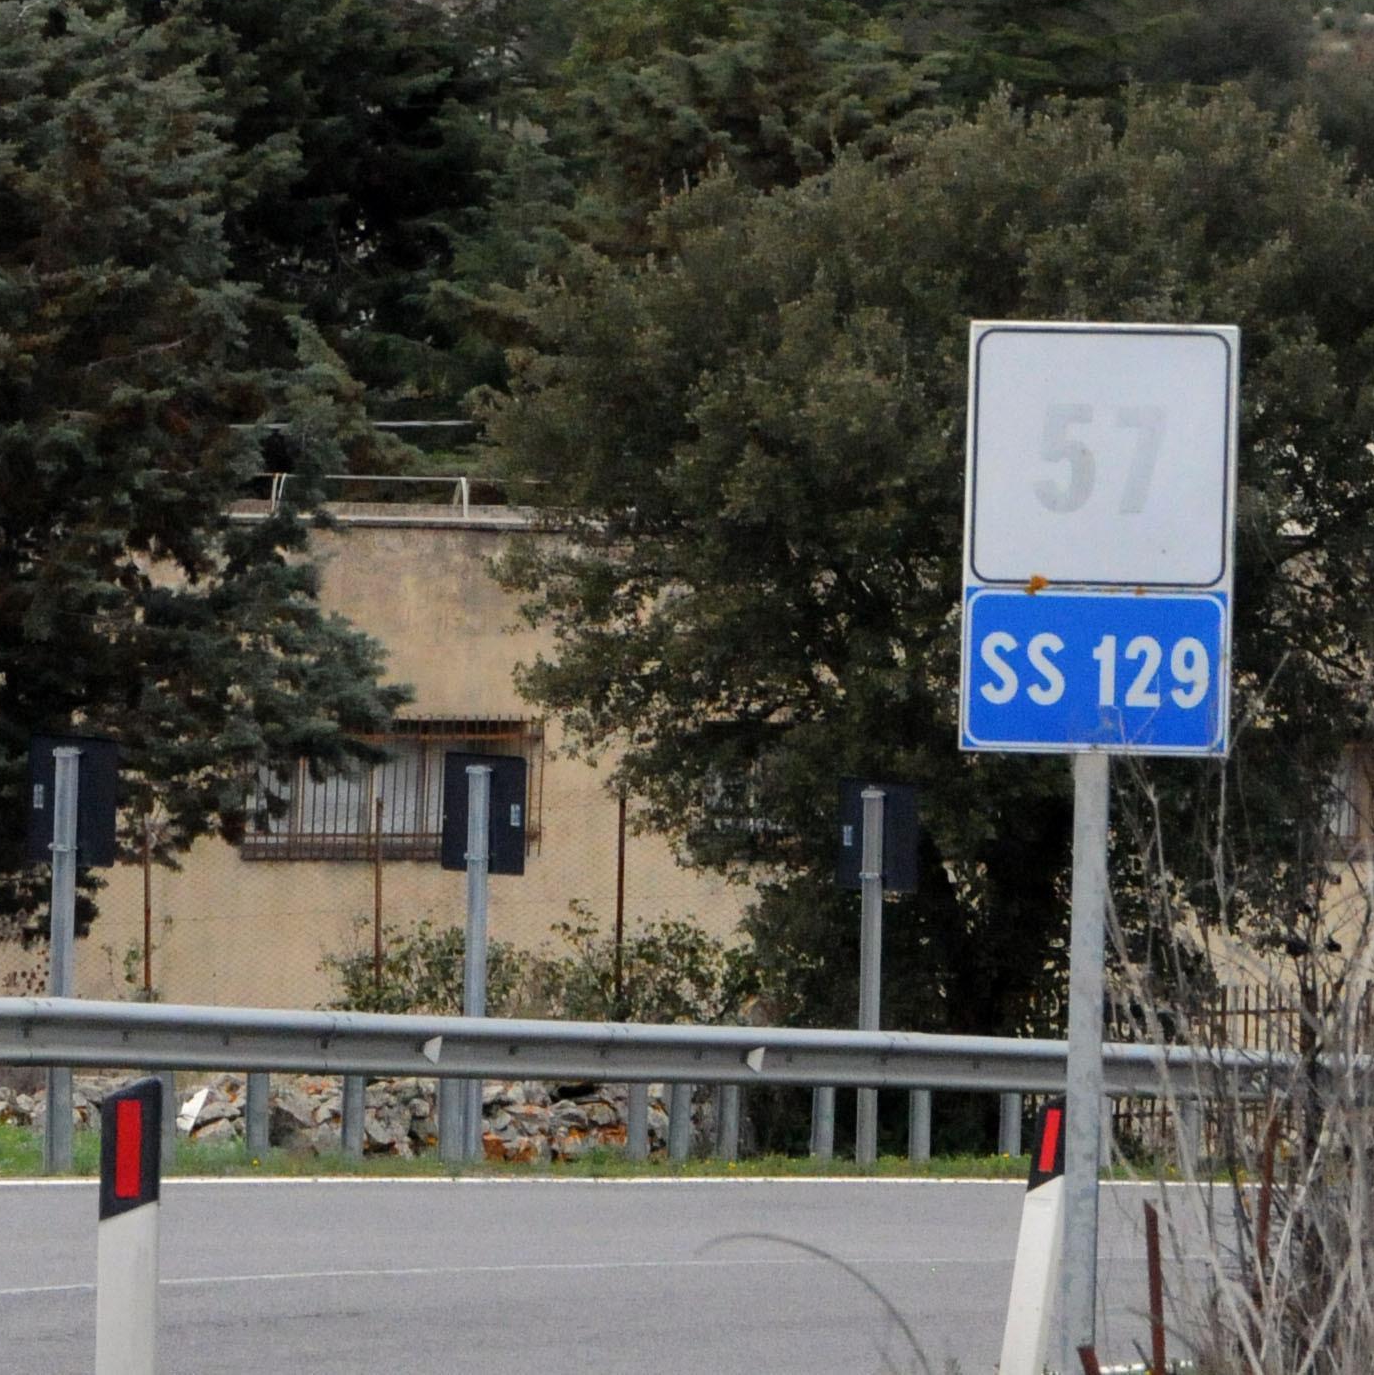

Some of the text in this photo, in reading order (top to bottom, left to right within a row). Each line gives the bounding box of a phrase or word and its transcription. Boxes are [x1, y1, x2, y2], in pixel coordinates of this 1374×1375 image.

[1033, 403, 1166, 514] 57
[980, 631, 1210, 709] SS 129
